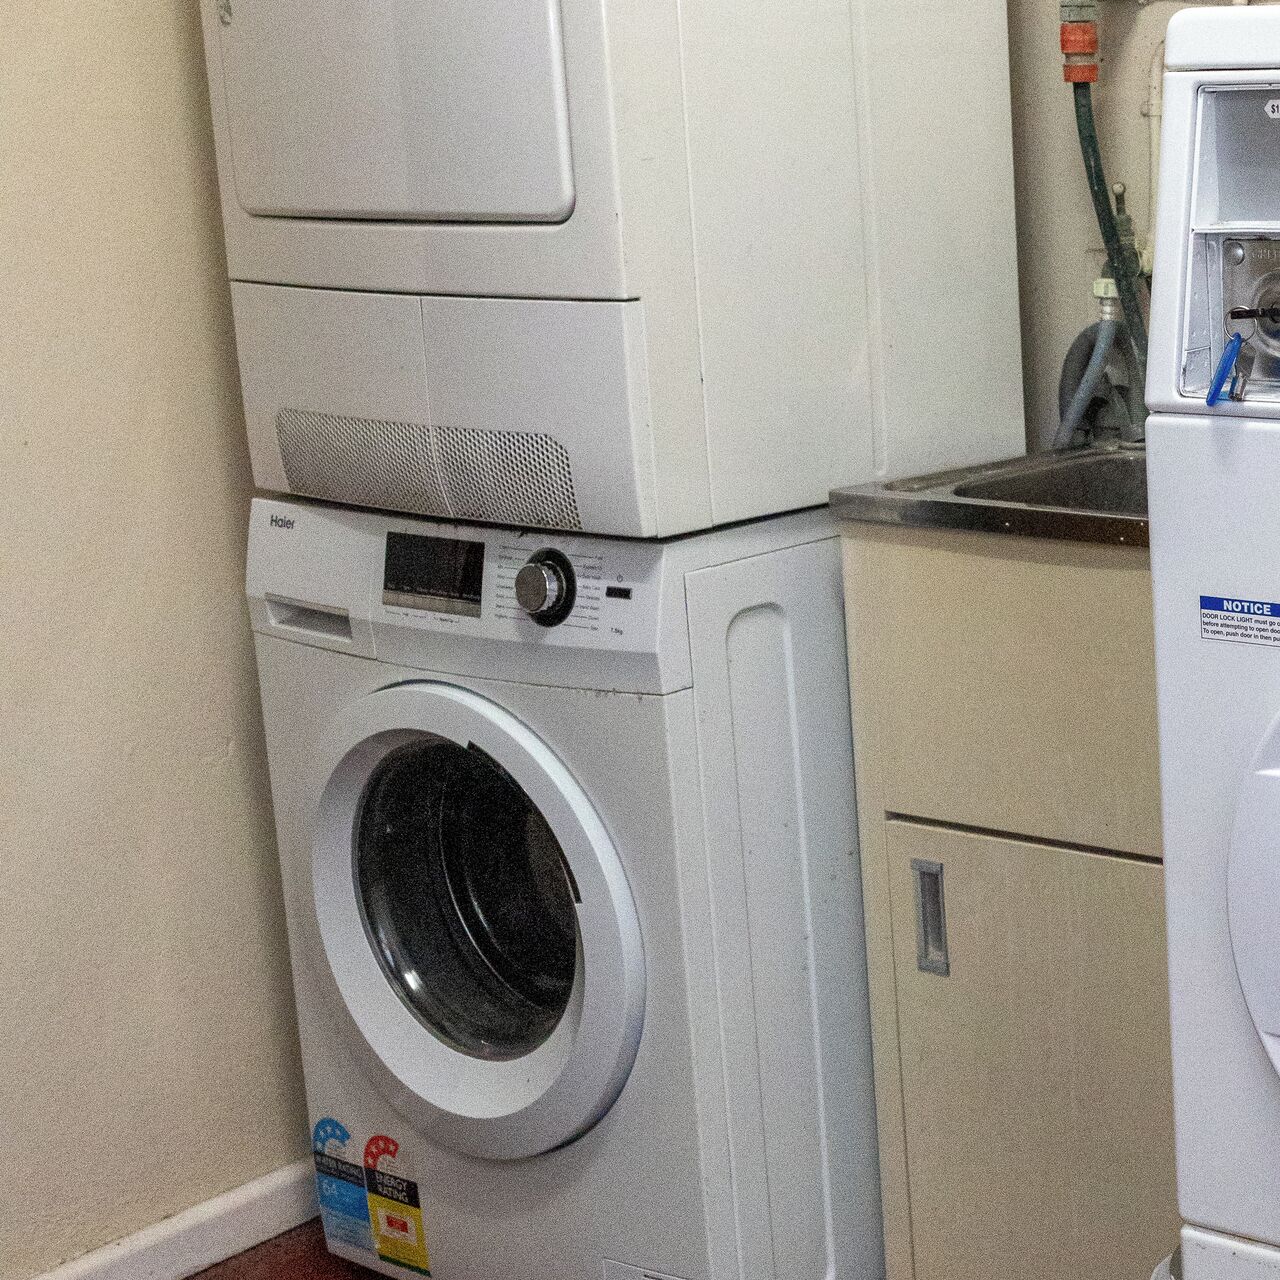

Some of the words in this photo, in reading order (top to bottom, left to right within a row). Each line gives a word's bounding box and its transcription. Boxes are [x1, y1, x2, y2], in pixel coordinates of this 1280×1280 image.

[1271, 104, 1280, 114] $1
[270, 514, 295, 529] Haier
[1223, 600, 1271, 615] NOTICE
[1220, 614, 1235, 622] LOCK
[1236, 616, 1253, 624] LIGHT
[1220, 623, 1248, 631] attempting
